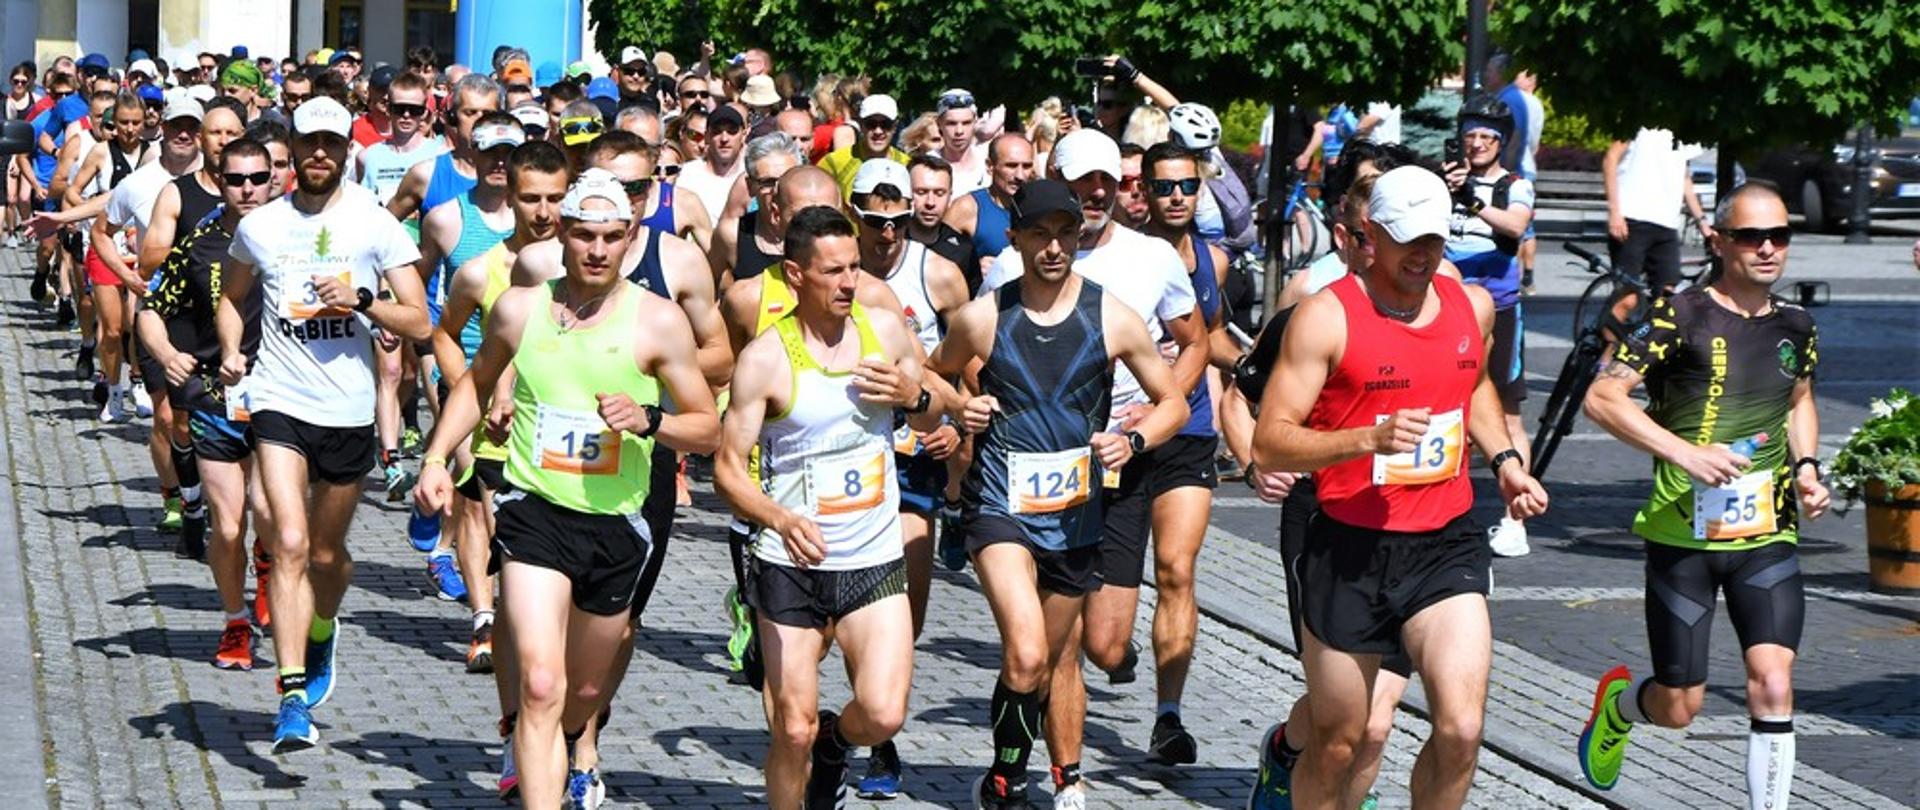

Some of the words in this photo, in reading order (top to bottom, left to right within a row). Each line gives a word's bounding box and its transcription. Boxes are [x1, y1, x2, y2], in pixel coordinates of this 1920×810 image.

[561, 430, 600, 461] 15
[1413, 437, 1445, 469] 13
[844, 469, 862, 497] 8
[1027, 466, 1081, 499] 124
[1724, 494, 1757, 525] 55
